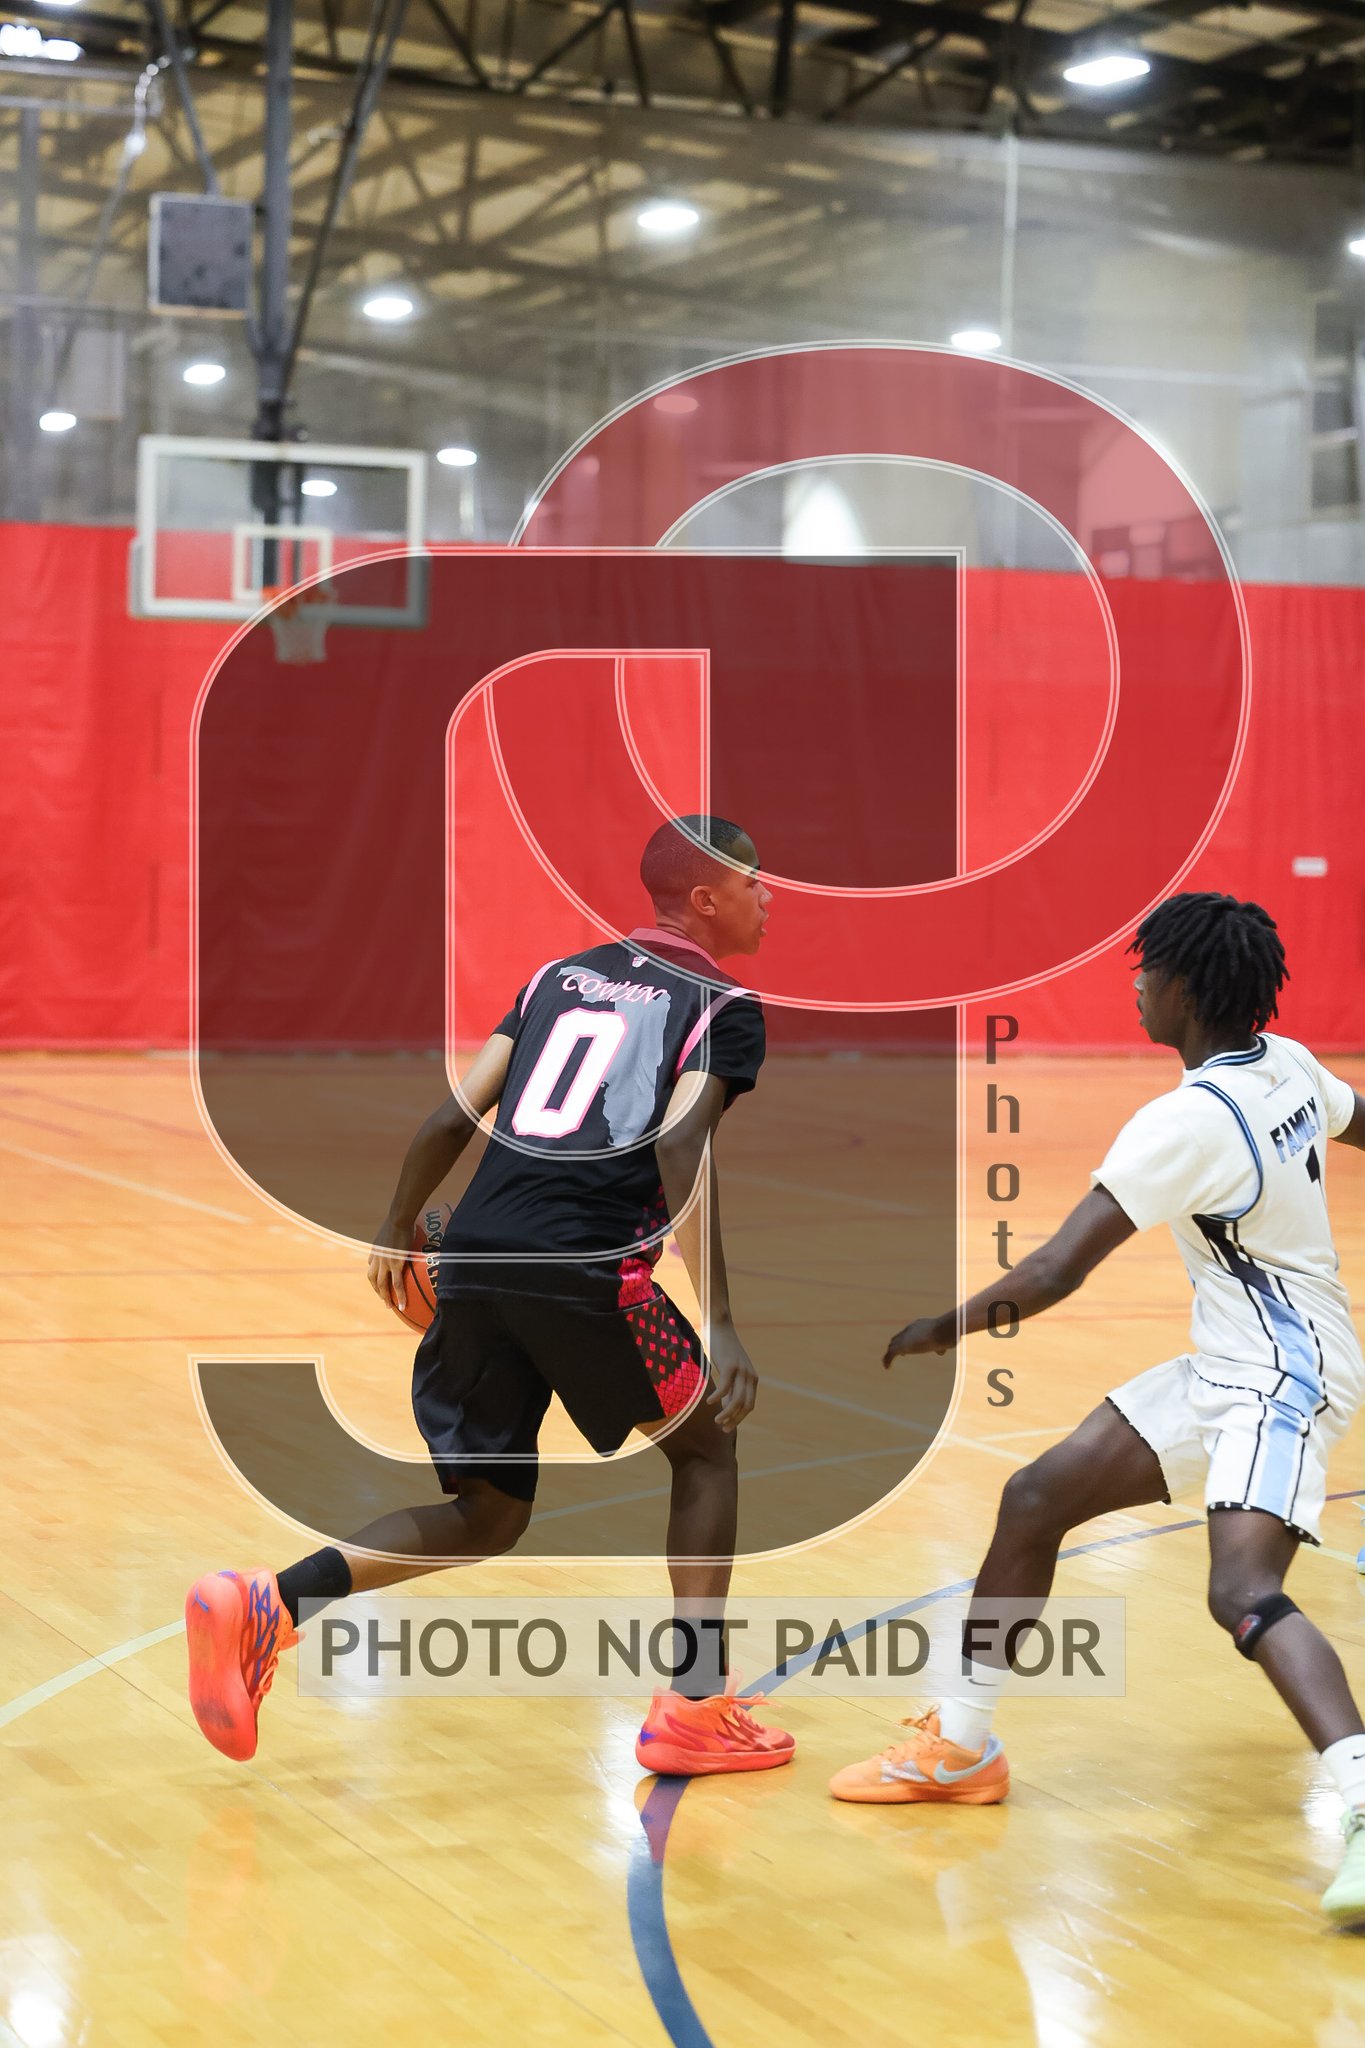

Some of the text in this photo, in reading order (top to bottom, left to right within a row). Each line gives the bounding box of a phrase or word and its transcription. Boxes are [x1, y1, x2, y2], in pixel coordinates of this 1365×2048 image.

[561, 973, 669, 1006] COWAN
[512, 1007, 628, 1139] 0
[1269, 1096, 1322, 1164] FAMILY
